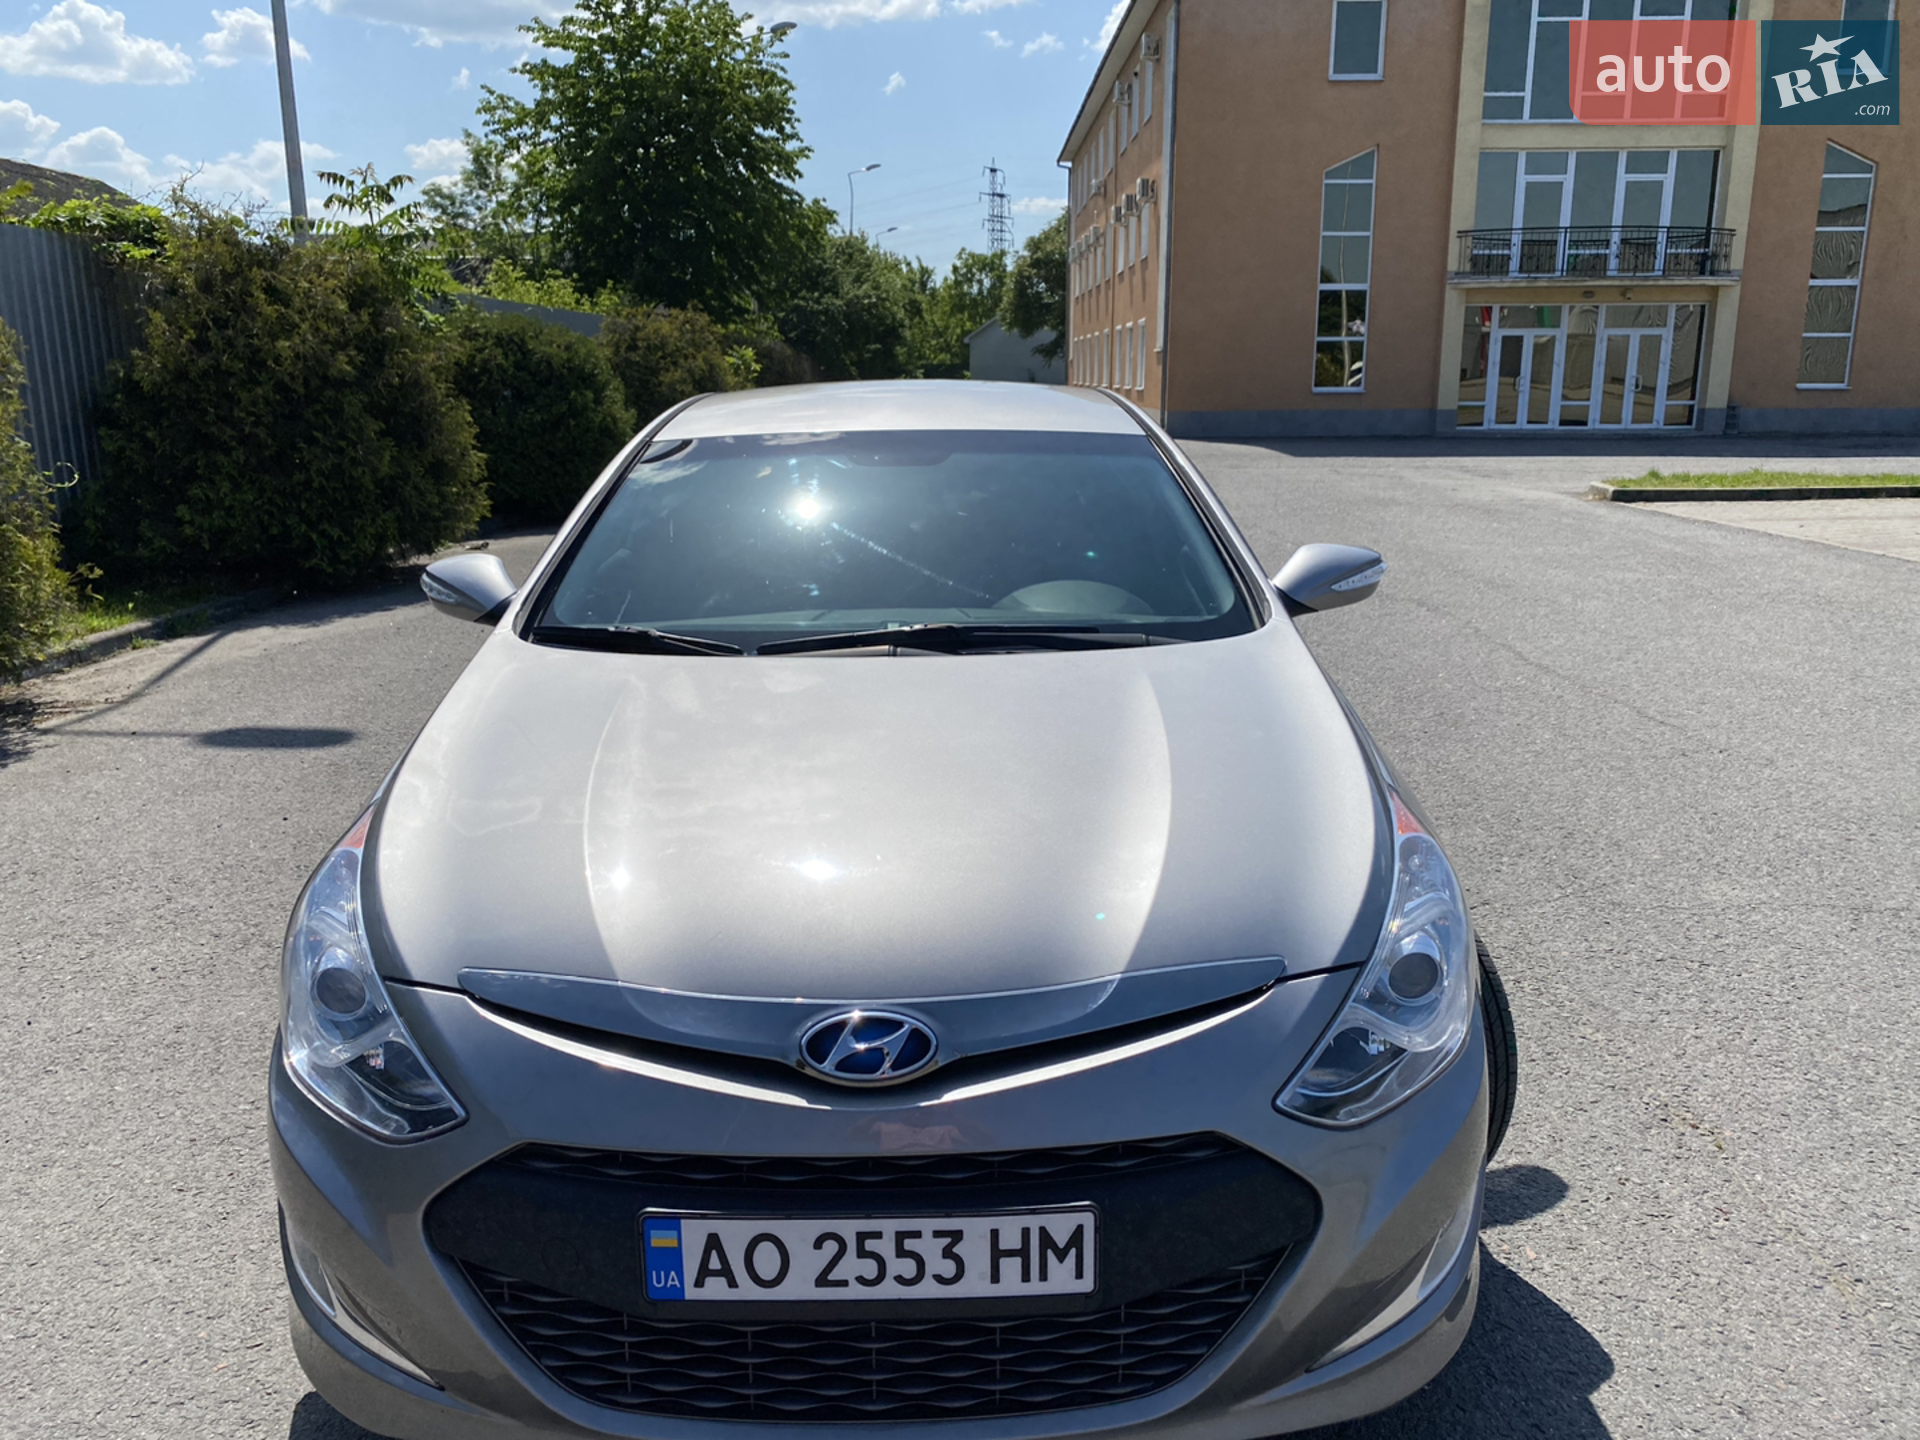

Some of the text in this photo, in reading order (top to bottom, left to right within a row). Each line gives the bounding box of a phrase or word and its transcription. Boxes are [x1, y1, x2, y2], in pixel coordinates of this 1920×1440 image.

[693, 1223, 1085, 1289] AO 2553 HM
[651, 1269, 681, 1288] UA
